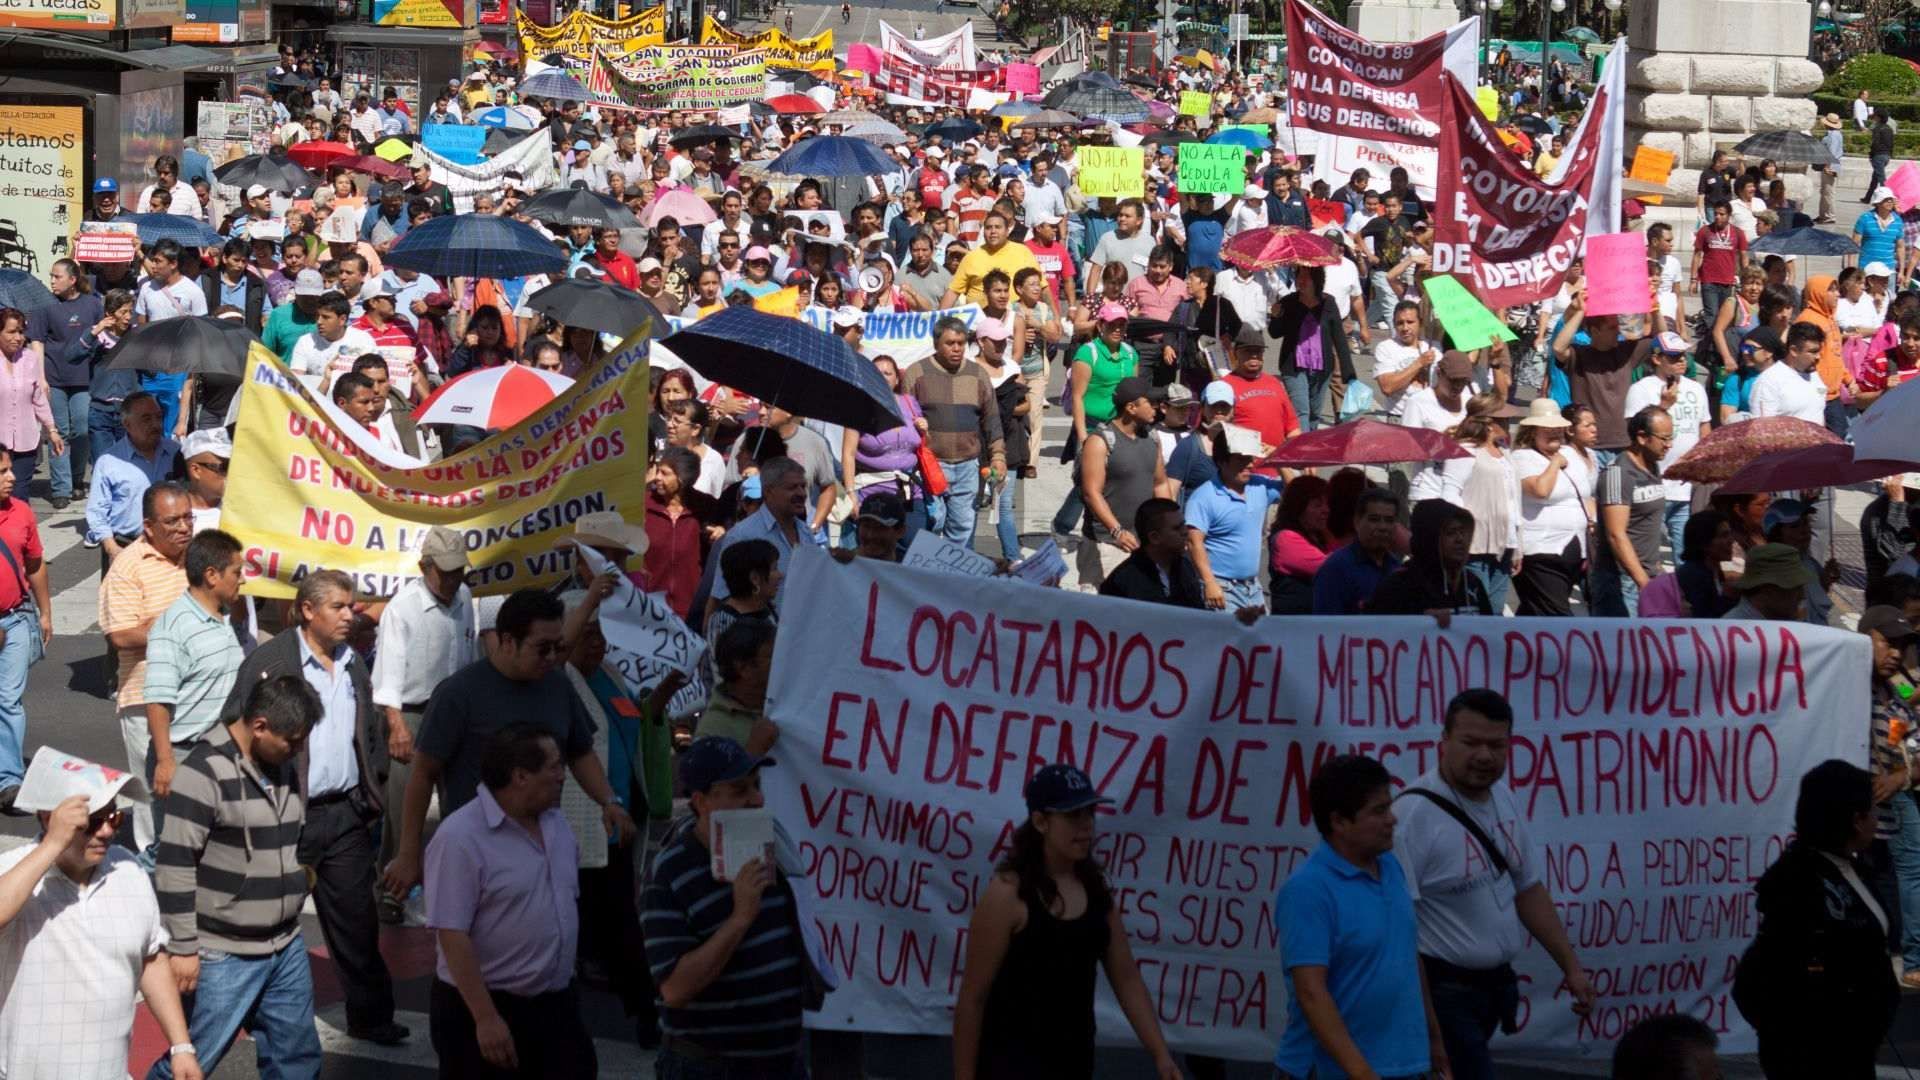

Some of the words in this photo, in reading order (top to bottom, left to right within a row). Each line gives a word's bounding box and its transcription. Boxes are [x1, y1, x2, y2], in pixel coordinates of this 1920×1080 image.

[1304, 17, 1387, 59] MERCADO
[1391, 46, 1415, 60] 89
[706, 53, 765, 69] JOAQUIN
[1308, 45, 1404, 81] COYOACAN
[699, 77, 712, 87] DE
[714, 73, 764, 86] GOBIERNO
[1311, 74, 1334, 96] LA
[1338, 79, 1420, 111] DEFENSA
[1297, 100, 1332, 123] SUS
[1180, 145, 1199, 160] NO
[57, 165, 73, 178] de
[1180, 161, 1231, 181] CEDULA
[1186, 180, 1228, 193] UNICA
[2, 184, 19, 197] de
[24, 184, 75, 198] ruedas
[288, 454, 322, 485] DE
[331, 466, 486, 509] NUESTROS
[475, 450, 512, 482] LA
[301, 506, 355, 547] NO
[365, 526, 385, 551] A
[463, 490, 618, 552] ONCESION,
[243, 546, 280, 582] SI
[860, 580, 1189, 720] LOCATARIOS
[1209, 644, 1299, 726] DEL
[1315, 630, 1491, 731] MERCADO
[1502, 624, 1809, 722] PROVIDENCIA
[821, 690, 910, 775] EN
[923, 700, 1168, 818] DEFENZA
[1186, 736, 1269, 827] DE
[1508, 723, 1779, 821] PATRIMONIO
[799, 782, 975, 861] VENIMOS
[1544, 842, 1591, 895] NO
[1600, 844, 1628, 891] A
[1171, 894, 1246, 949] SUS
[876, 922, 938, 988] UN
